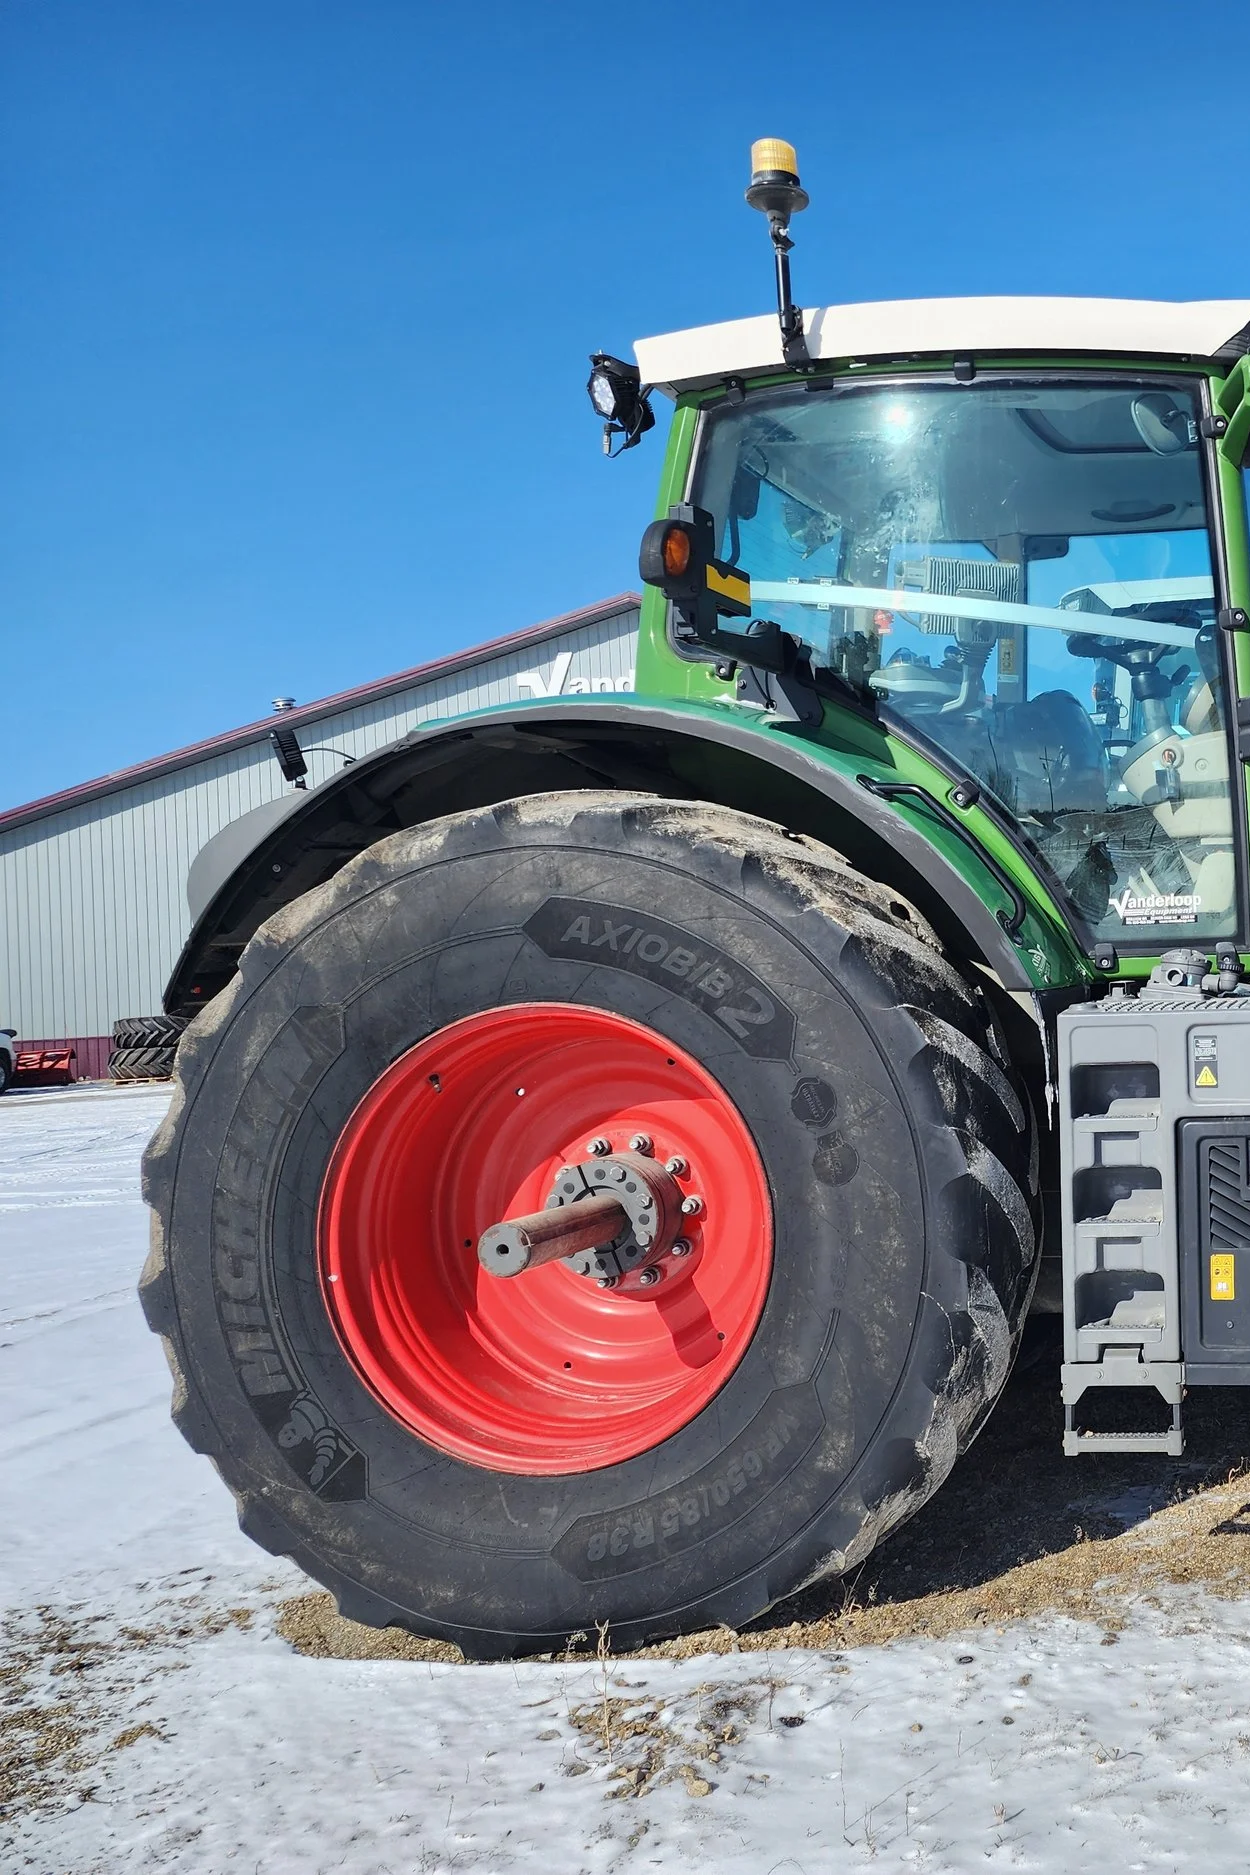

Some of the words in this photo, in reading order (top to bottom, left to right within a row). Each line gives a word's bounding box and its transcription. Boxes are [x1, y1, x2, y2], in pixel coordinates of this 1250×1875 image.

[1109, 889, 1202, 919] Vanderloop
[1143, 907, 1193, 916] Equipment
[560, 915, 736, 1000] AXIOBIB
[712, 985, 777, 1041] 2
